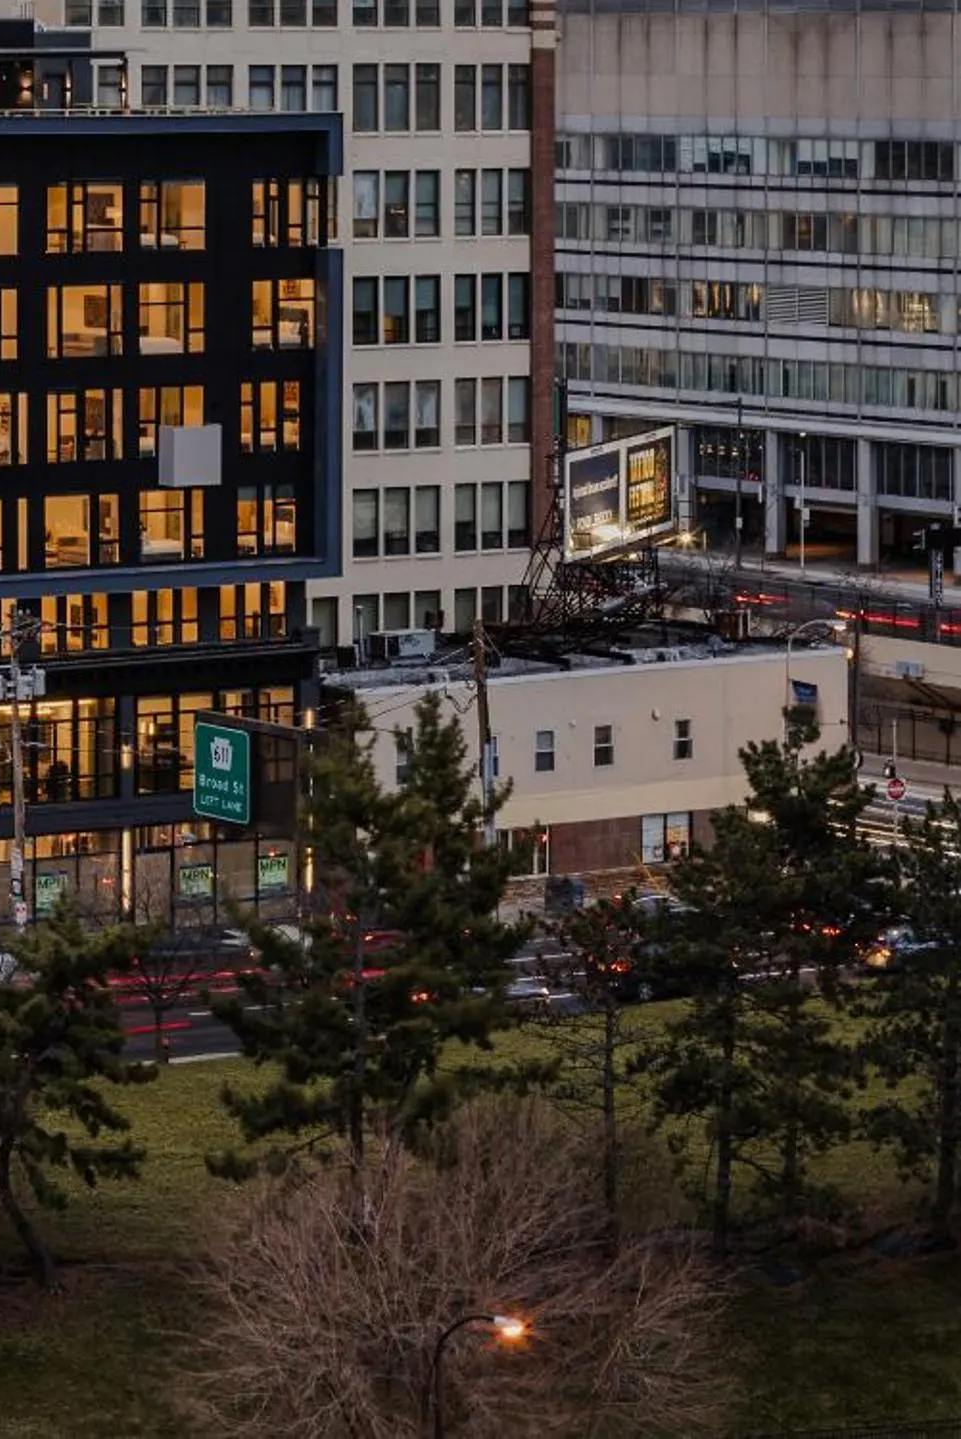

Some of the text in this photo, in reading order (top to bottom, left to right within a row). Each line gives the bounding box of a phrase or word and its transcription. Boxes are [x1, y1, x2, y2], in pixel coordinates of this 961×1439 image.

[199, 774, 244, 795] Broad St
[222, 800, 243, 813] LANE
